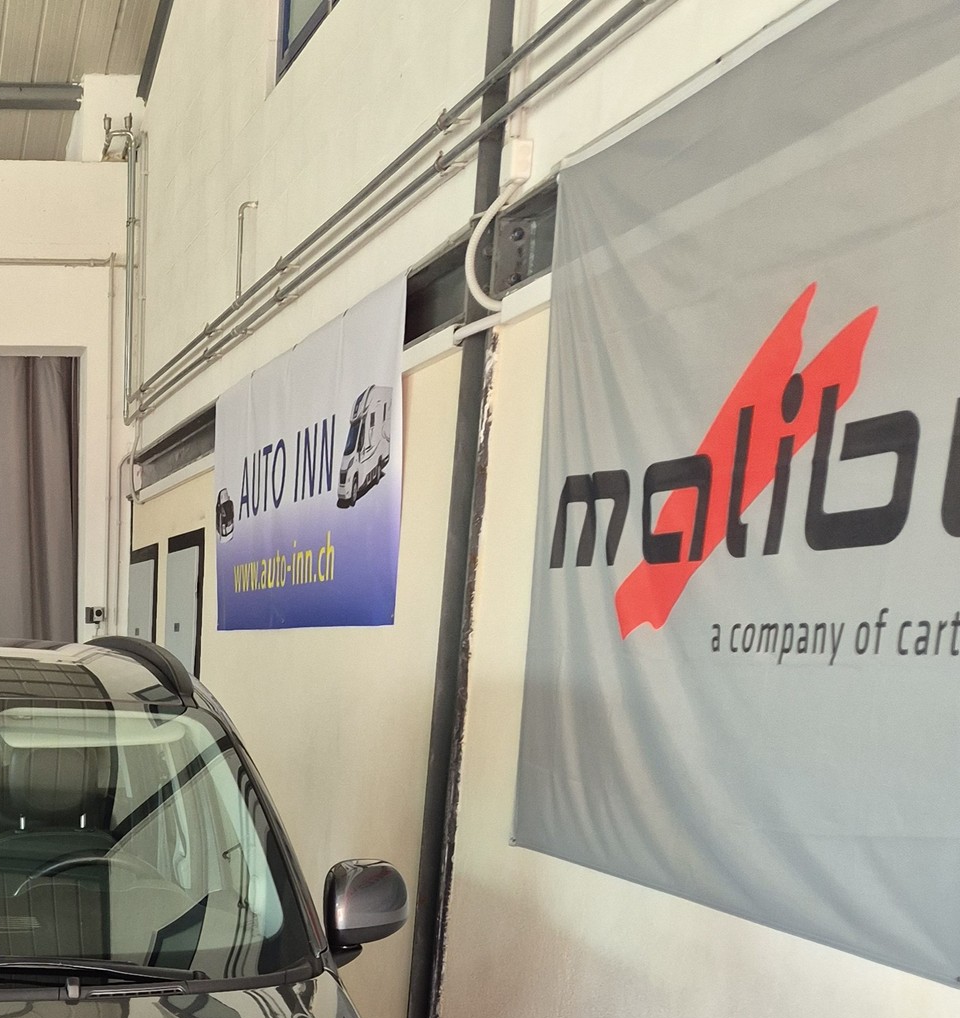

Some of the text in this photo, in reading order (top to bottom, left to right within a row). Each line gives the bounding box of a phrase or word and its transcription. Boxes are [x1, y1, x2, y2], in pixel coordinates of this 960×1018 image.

[238, 414, 336, 521] AUTO INN
[549, 373, 960, 569] malib
[233, 530, 335, 593] www.auto-inn.ch
[711, 607, 960, 666] a company of cart
